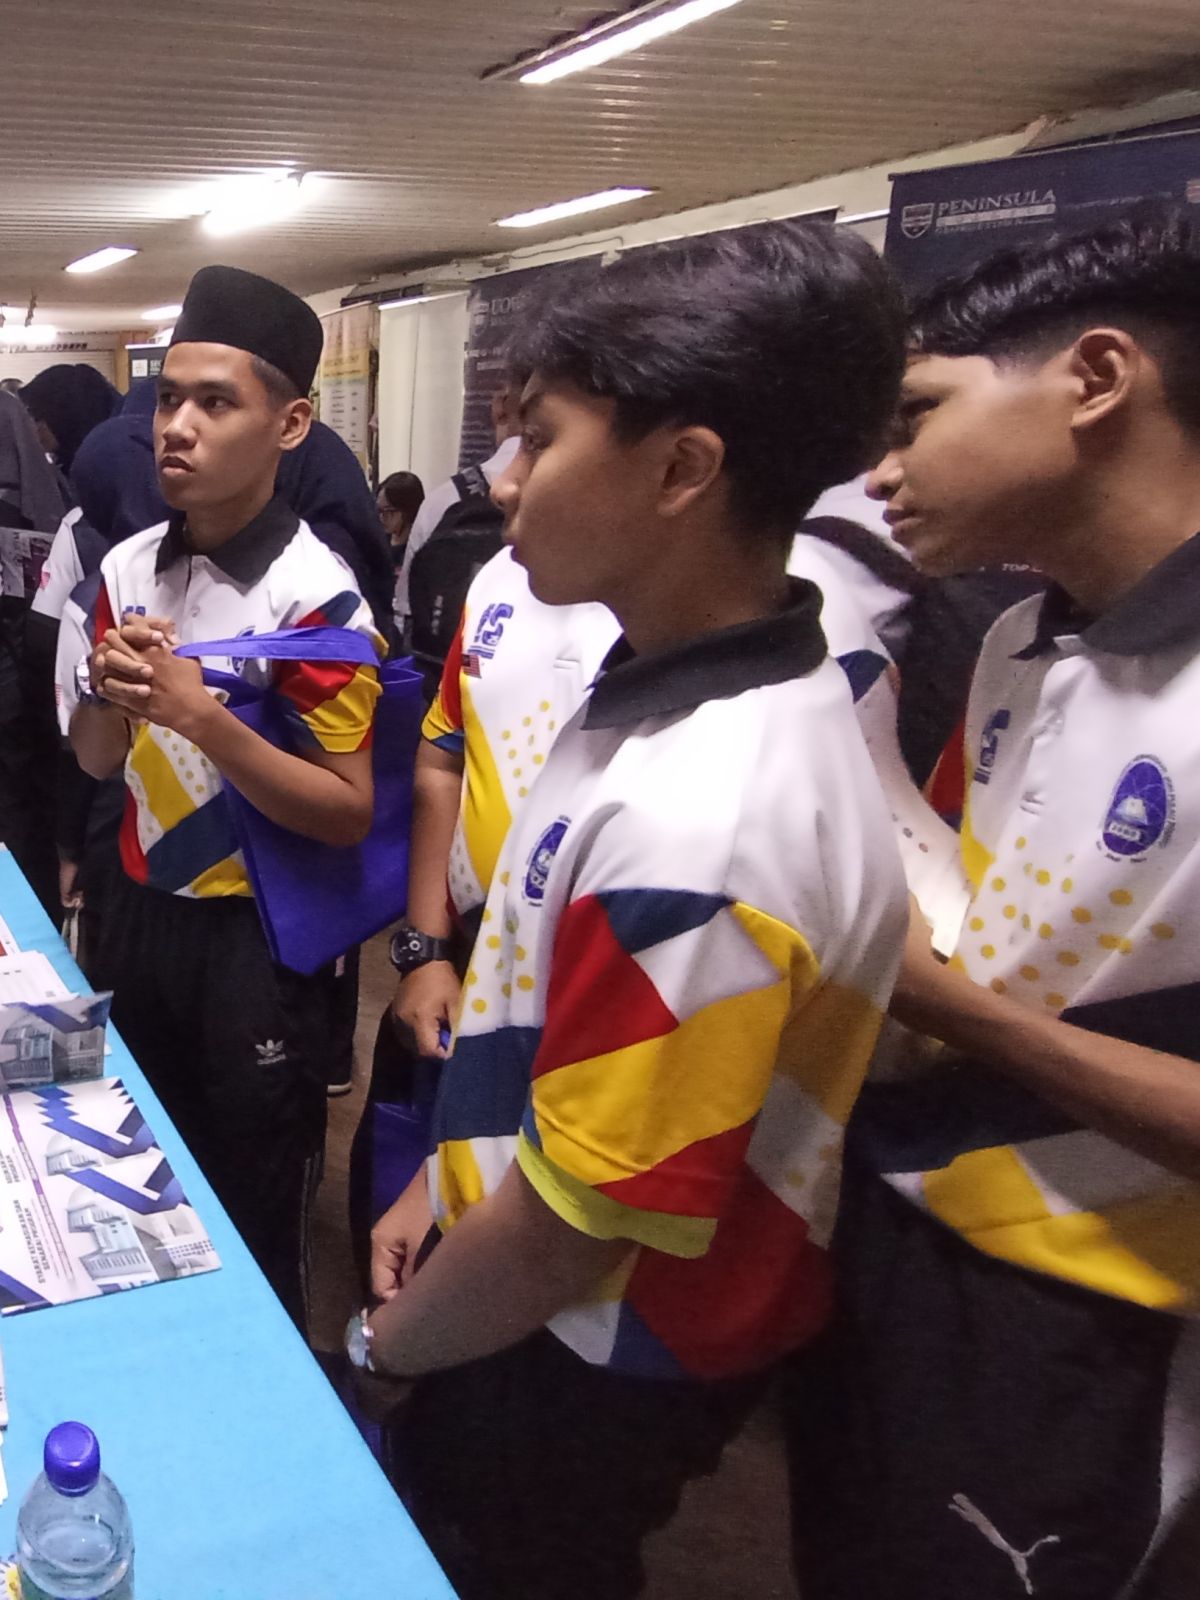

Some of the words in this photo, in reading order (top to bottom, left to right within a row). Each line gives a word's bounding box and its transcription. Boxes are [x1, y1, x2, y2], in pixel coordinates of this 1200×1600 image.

[939, 189, 1057, 216] PENINSULA
[13, 1199, 23, 1214] DAN
[17, 1213, 36, 1255] KEMASUKAN
[24, 1207, 40, 1239] PROGRAM
[31, 1255, 46, 1284] SYARAT
[35, 1239, 51, 1271] SENARAI
